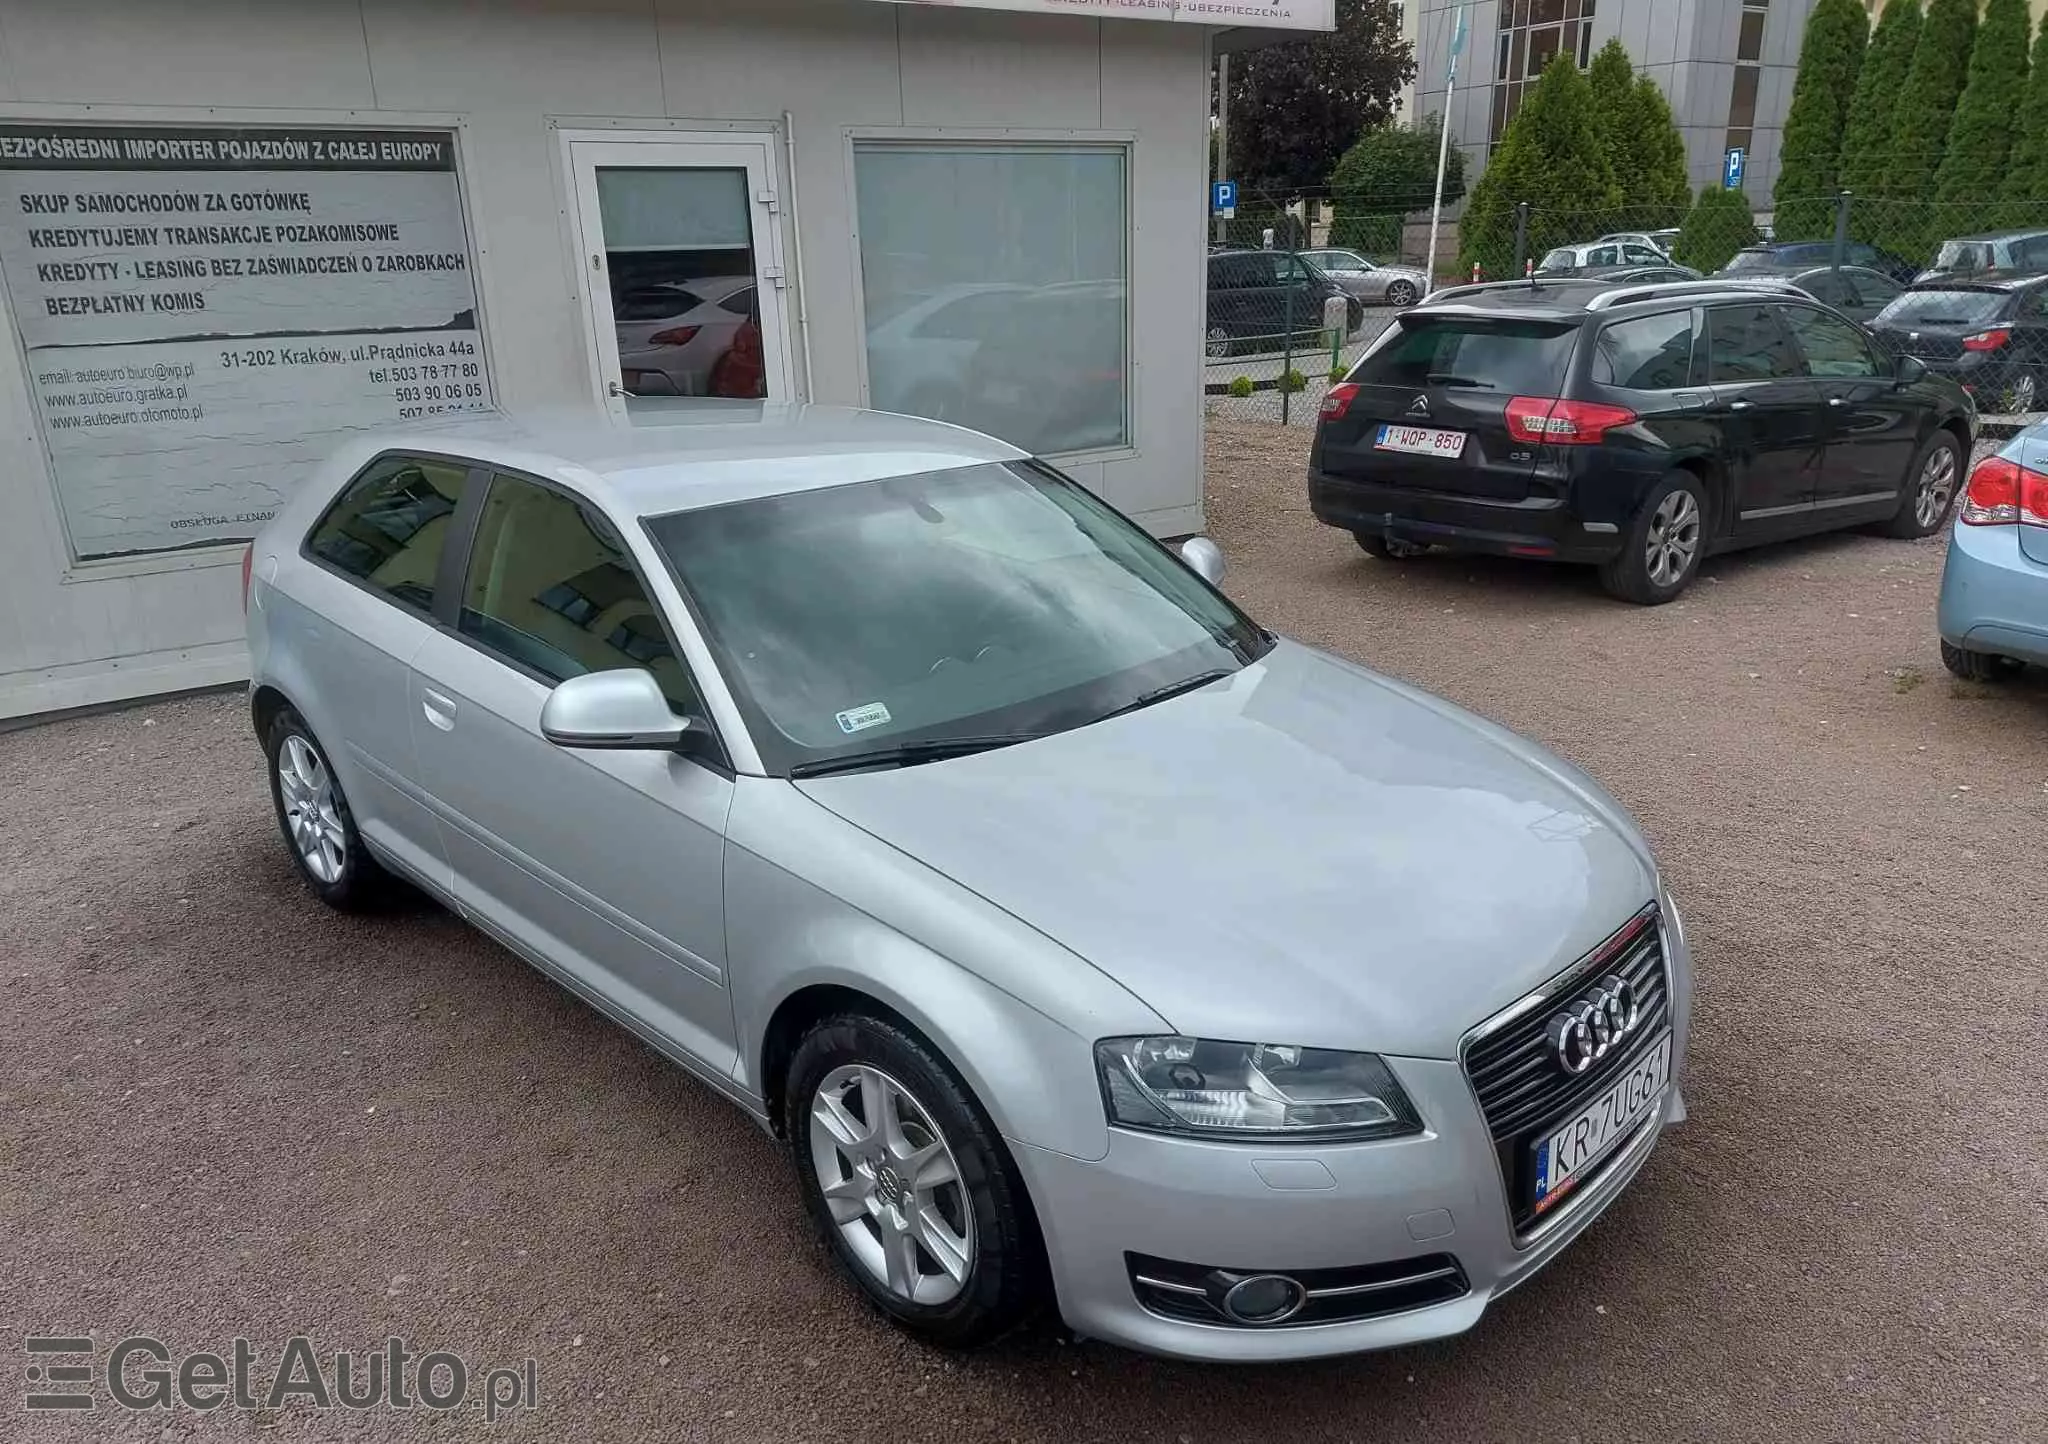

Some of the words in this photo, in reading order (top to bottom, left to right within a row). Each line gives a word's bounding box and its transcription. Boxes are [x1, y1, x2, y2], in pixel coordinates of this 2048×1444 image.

[0, 135, 120, 159] EZPOŚREDNI
[124, 139, 216, 160] IMPORTER
[219, 137, 308, 160] POJAZDÓW
[313, 141, 324, 160] Z
[328, 141, 377, 160] CAŁEJ
[381, 142, 441, 161] EUROPY
[1730, 152, 1739, 176] P
[20, 194, 70, 213] SKUP
[77, 190, 200, 213] SAMOCHODÓW
[204, 193, 228, 212] ZA
[231, 189, 312, 215] GOTÓWKĘ
[1219, 186, 1231, 204] P
[29, 228, 158, 248] KREDYTUJEMY
[164, 226, 273, 245] TRANSAKCJE
[276, 224, 399, 243] POZAKOMISOWE
[37, 262, 118, 282] KREDYTY
[134, 259, 206, 279] LEASING
[211, 258, 243, 277] BEZ
[246, 251, 358, 275] ZAŚWIADCZEŃ
[362, 255, 372, 273] O
[377, 253, 465, 272] ZAROBKACH
[45, 295, 145, 315] BEZPŁATNY
[151, 291, 205, 311] KOMIS
[221, 350, 276, 368] 31-202
[280, 346, 346, 364] Kraków,
[449, 340, 474, 355] 44a
[421, 365, 438, 380] 78
[441, 364, 457, 378] 77
[462, 363, 478, 377] 80
[395, 386, 421, 402] 503
[424, 385, 441, 400] 90
[445, 384, 461, 398] 06
[465, 383, 482, 397] 05
[1555, 1117, 1590, 1181] KR
[1536, 1176, 1546, 1192] PL
